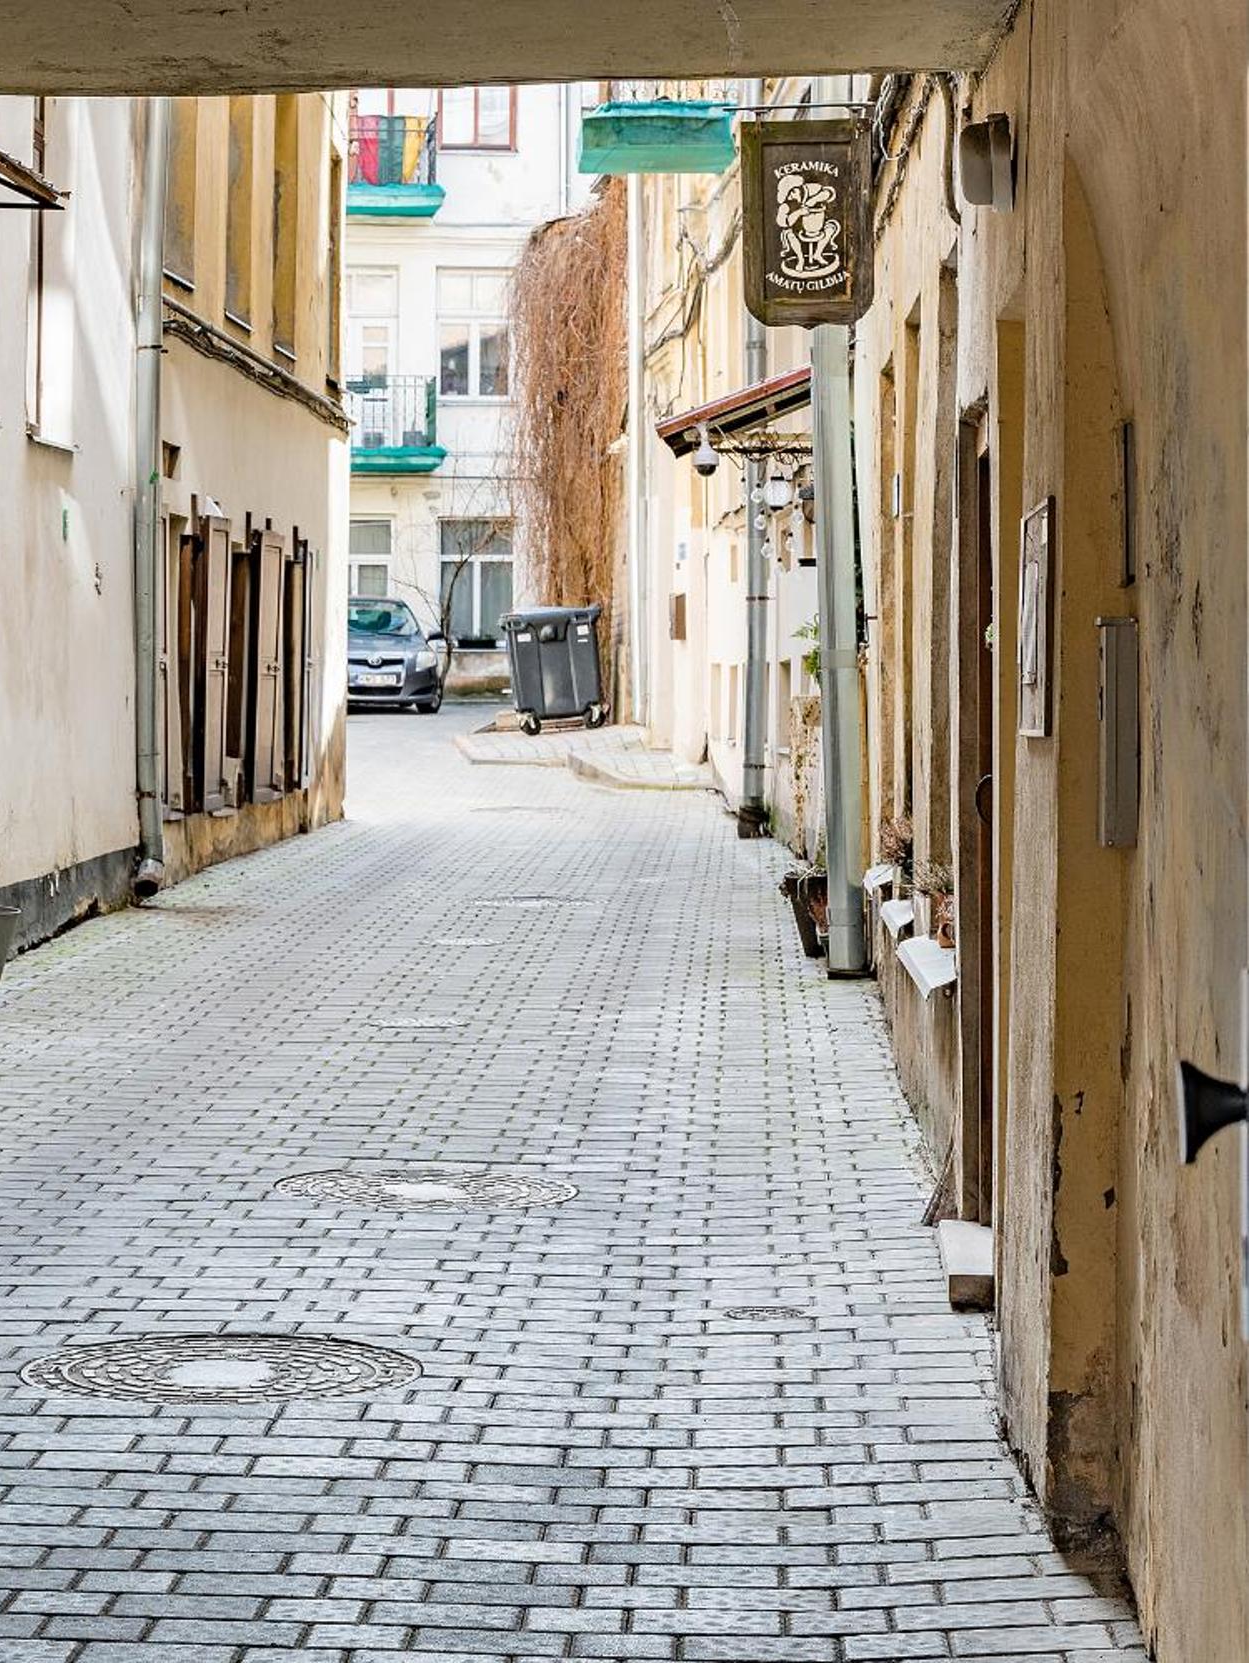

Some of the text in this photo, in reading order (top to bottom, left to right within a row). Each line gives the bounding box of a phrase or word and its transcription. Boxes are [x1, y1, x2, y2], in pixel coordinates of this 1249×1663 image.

[774, 161, 838, 179] KERAMIKA
[766, 271, 849, 294] AMATŲ GILDIJA
